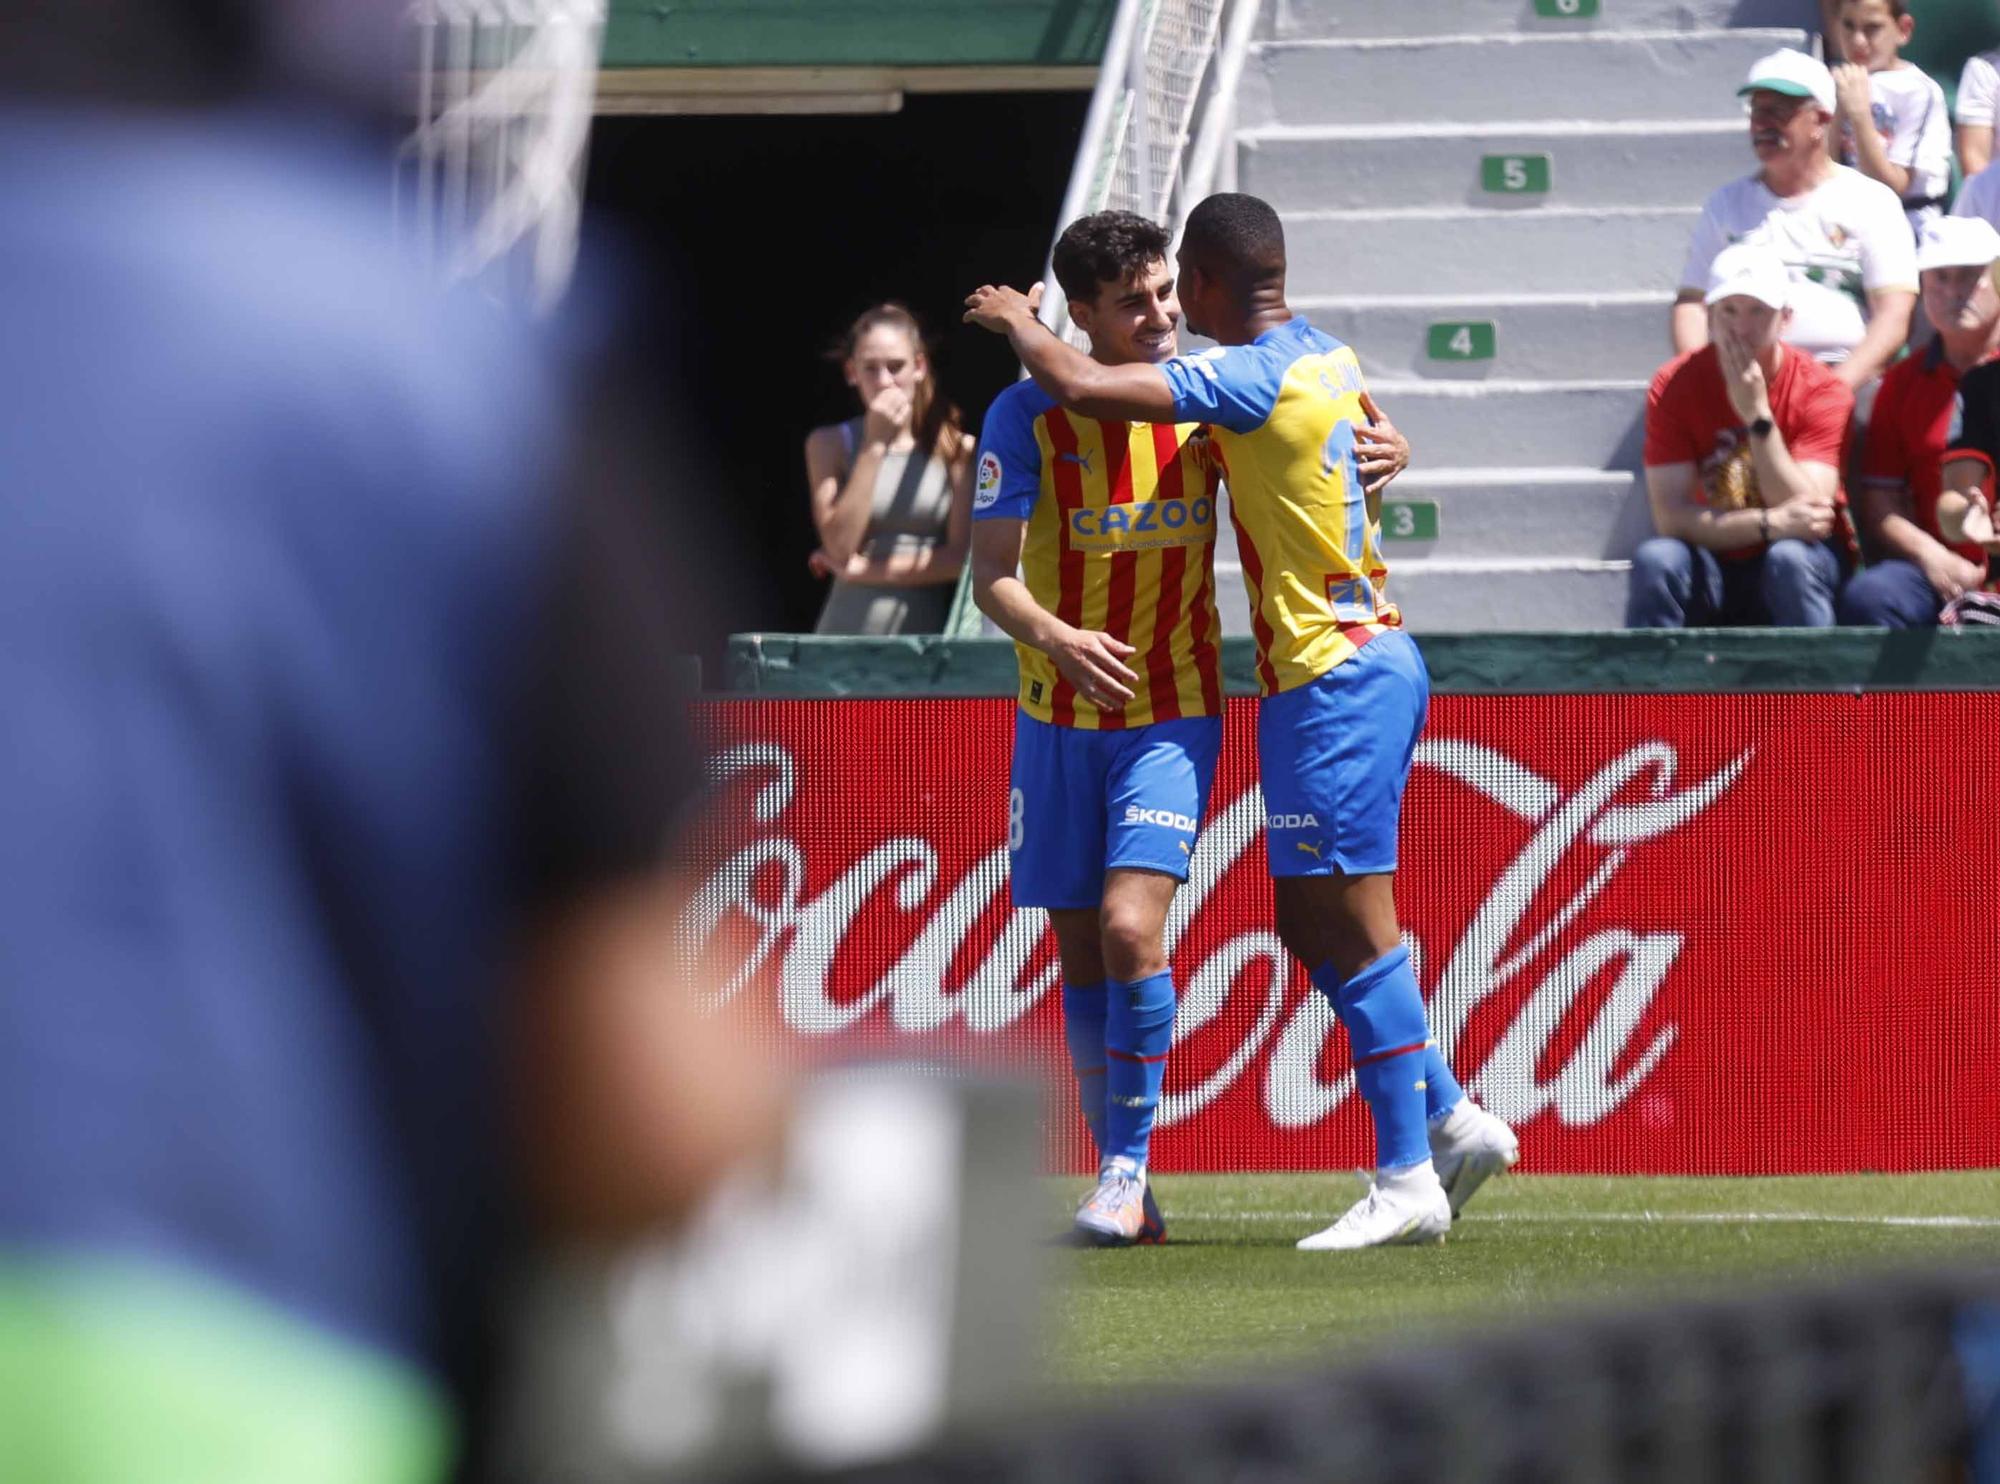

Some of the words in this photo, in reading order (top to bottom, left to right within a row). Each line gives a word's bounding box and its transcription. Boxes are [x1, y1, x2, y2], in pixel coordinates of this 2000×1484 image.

[1502, 158, 1528, 189] 5
[1449, 326, 1473, 356] 4
[1071, 497, 1212, 536] CAZOO
[1392, 505, 1415, 536] 3
[1124, 804, 1197, 833] ŠKODA
[672, 738, 1756, 1131] ocaCola
